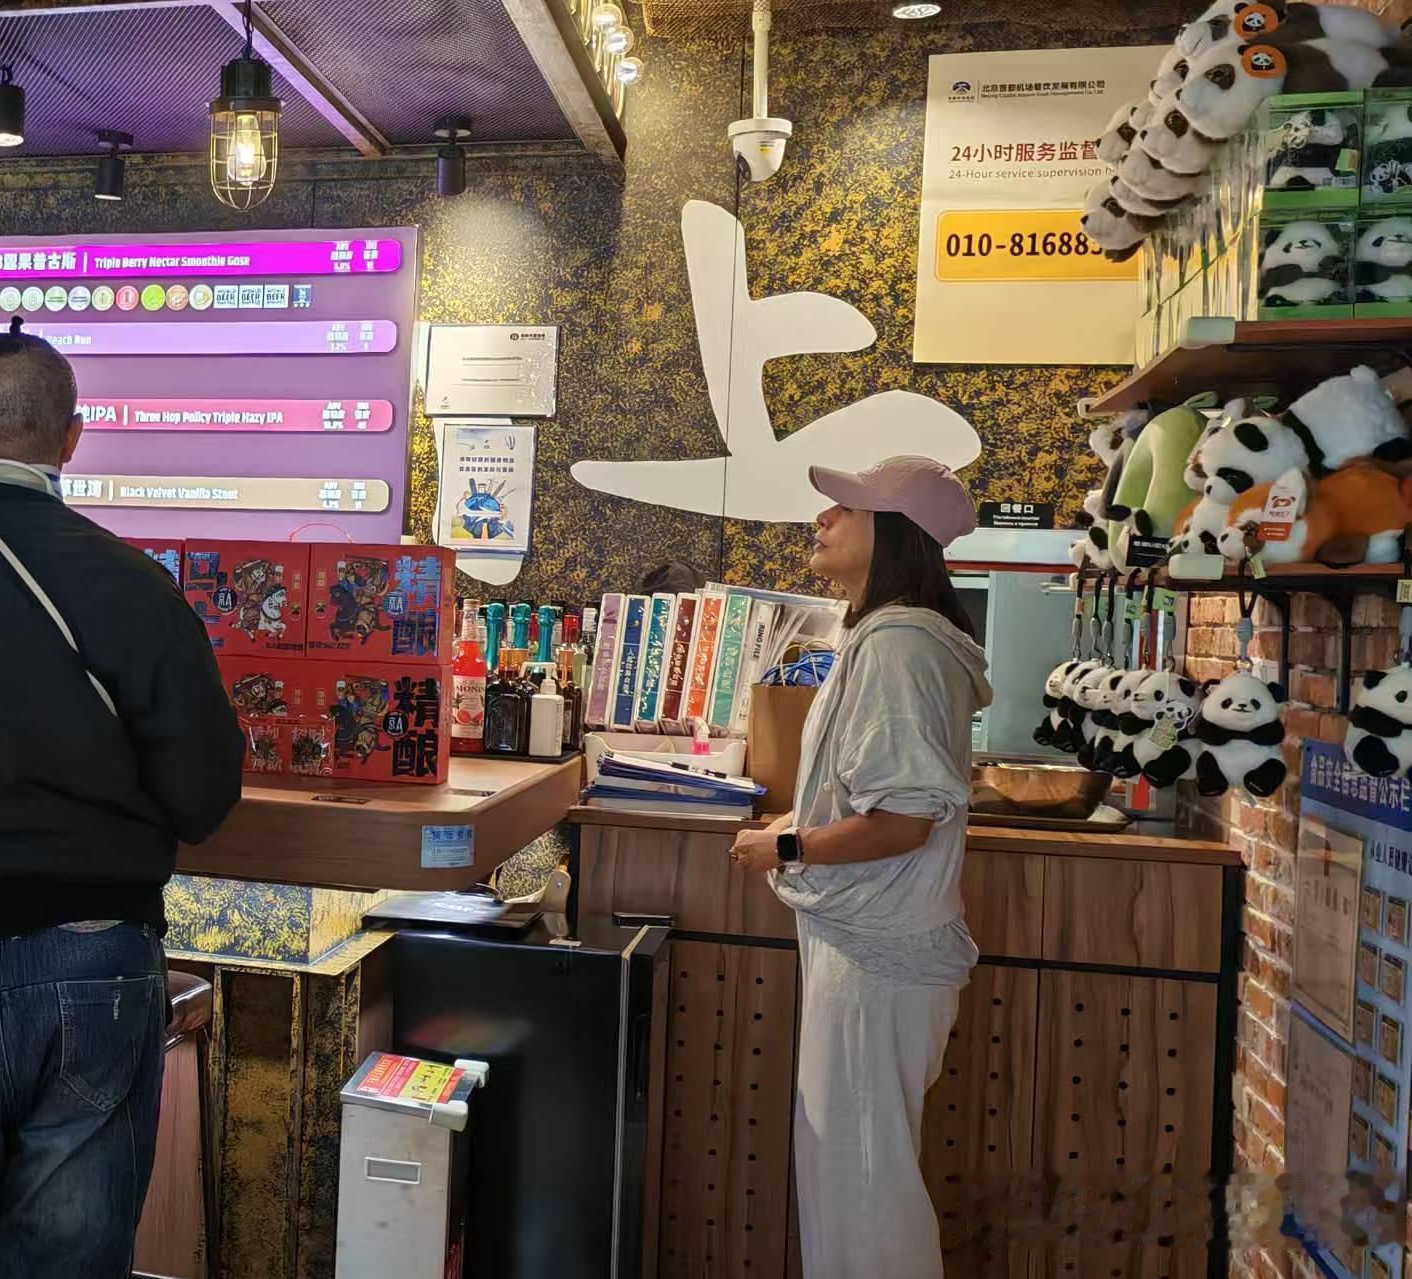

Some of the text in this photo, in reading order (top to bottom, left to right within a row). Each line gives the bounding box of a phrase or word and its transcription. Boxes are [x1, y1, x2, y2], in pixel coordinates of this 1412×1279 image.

[951, 141, 1098, 163] 24小时服务监督
[949, 169, 992, 179] 24-Hour
[995, 168, 1034, 178] service
[1037, 166, 1101, 178] supervision
[95, 256, 120, 269] Triple
[122, 256, 148, 269] Berry
[149, 256, 179, 267] Nectar
[181, 255, 225, 266] Smoothie
[227, 255, 250, 266] Gose
[570, 199, 982, 523] 上
[135, 410, 161, 423] Three
[162, 410, 181, 425] Hop
[182, 410, 212, 425] Policy
[213, 410, 240, 424] Triple
[241, 411, 265, 425] Hazy
[120, 486, 145, 498] Black
[146, 487, 176, 499] Velvet
[178, 487, 210, 500] Vanilla
[211, 488, 238, 500] Stout
